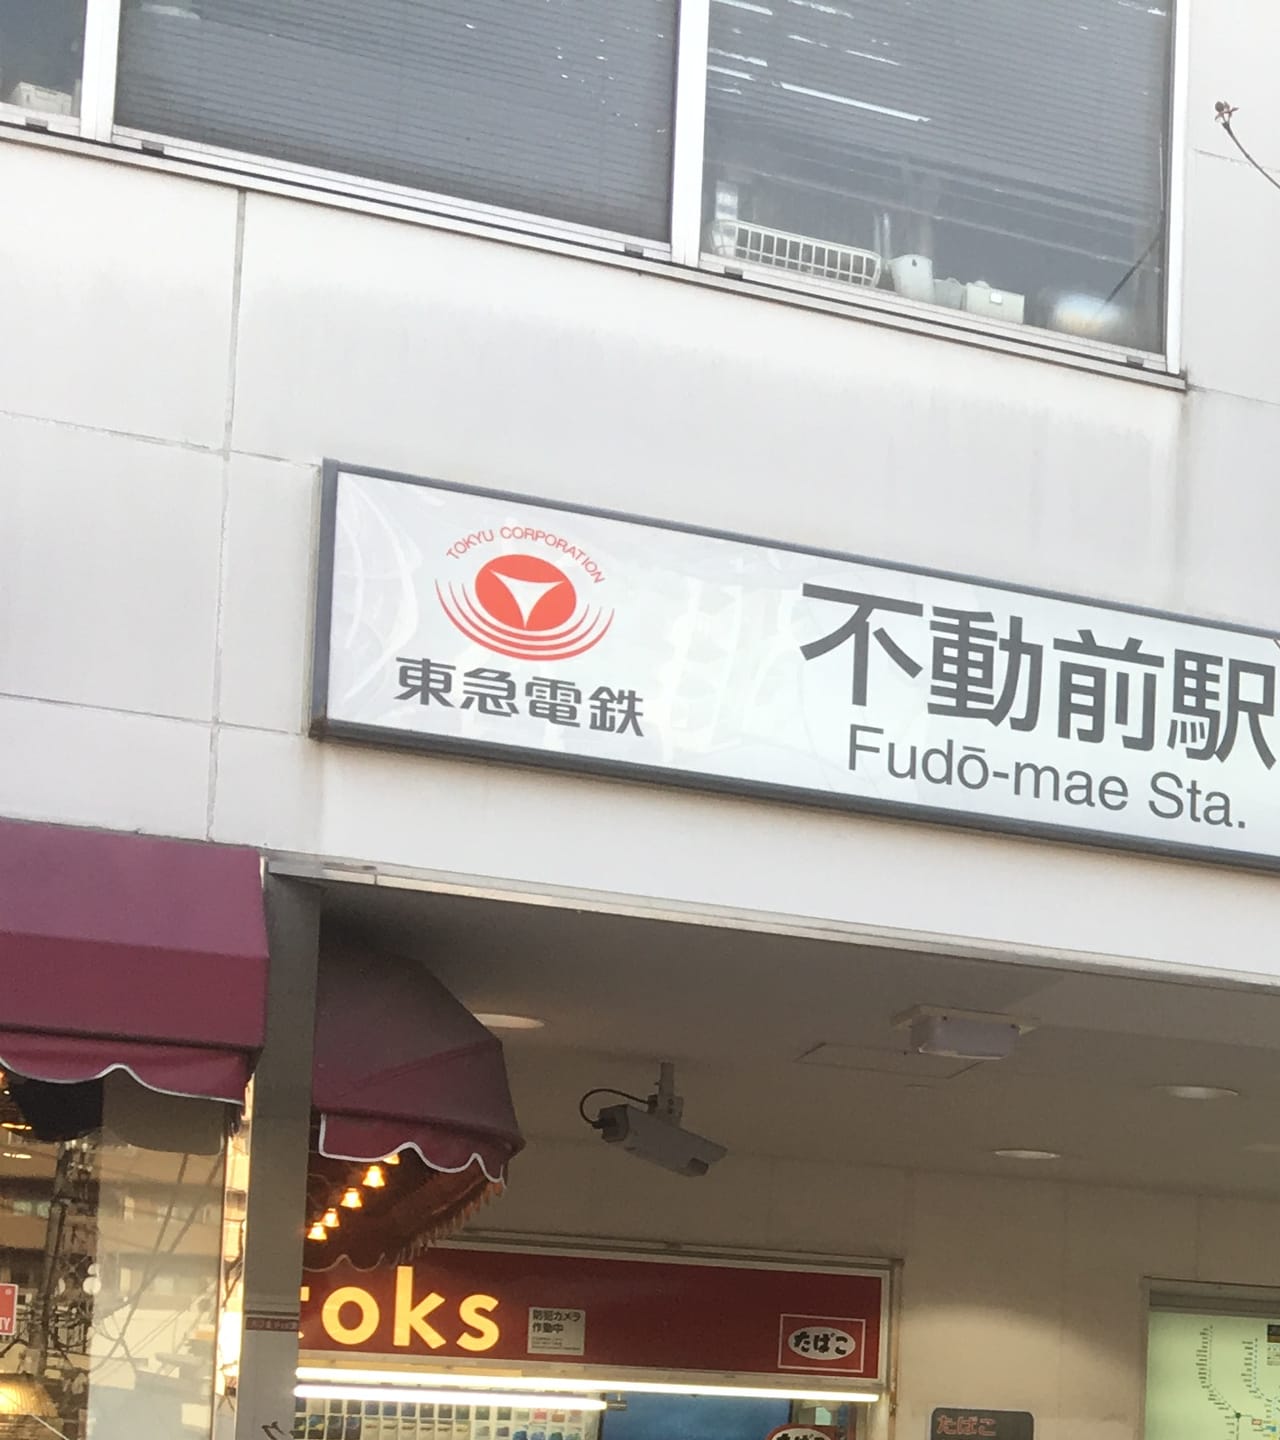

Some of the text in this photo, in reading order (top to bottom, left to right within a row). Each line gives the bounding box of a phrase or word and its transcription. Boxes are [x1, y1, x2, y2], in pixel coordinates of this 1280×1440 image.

[446, 526, 605, 584] TOKYU CORPORATION
[393, 657, 645, 737] 東急電鉄
[799, 582, 1277, 770] 不動前駅
[848, 723, 1247, 829] Fudō-mae Sta.
[299, 1265, 500, 1352] oks
[793, 1331, 849, 1355] たばこ
[936, 1414, 997, 1437] たばこ
